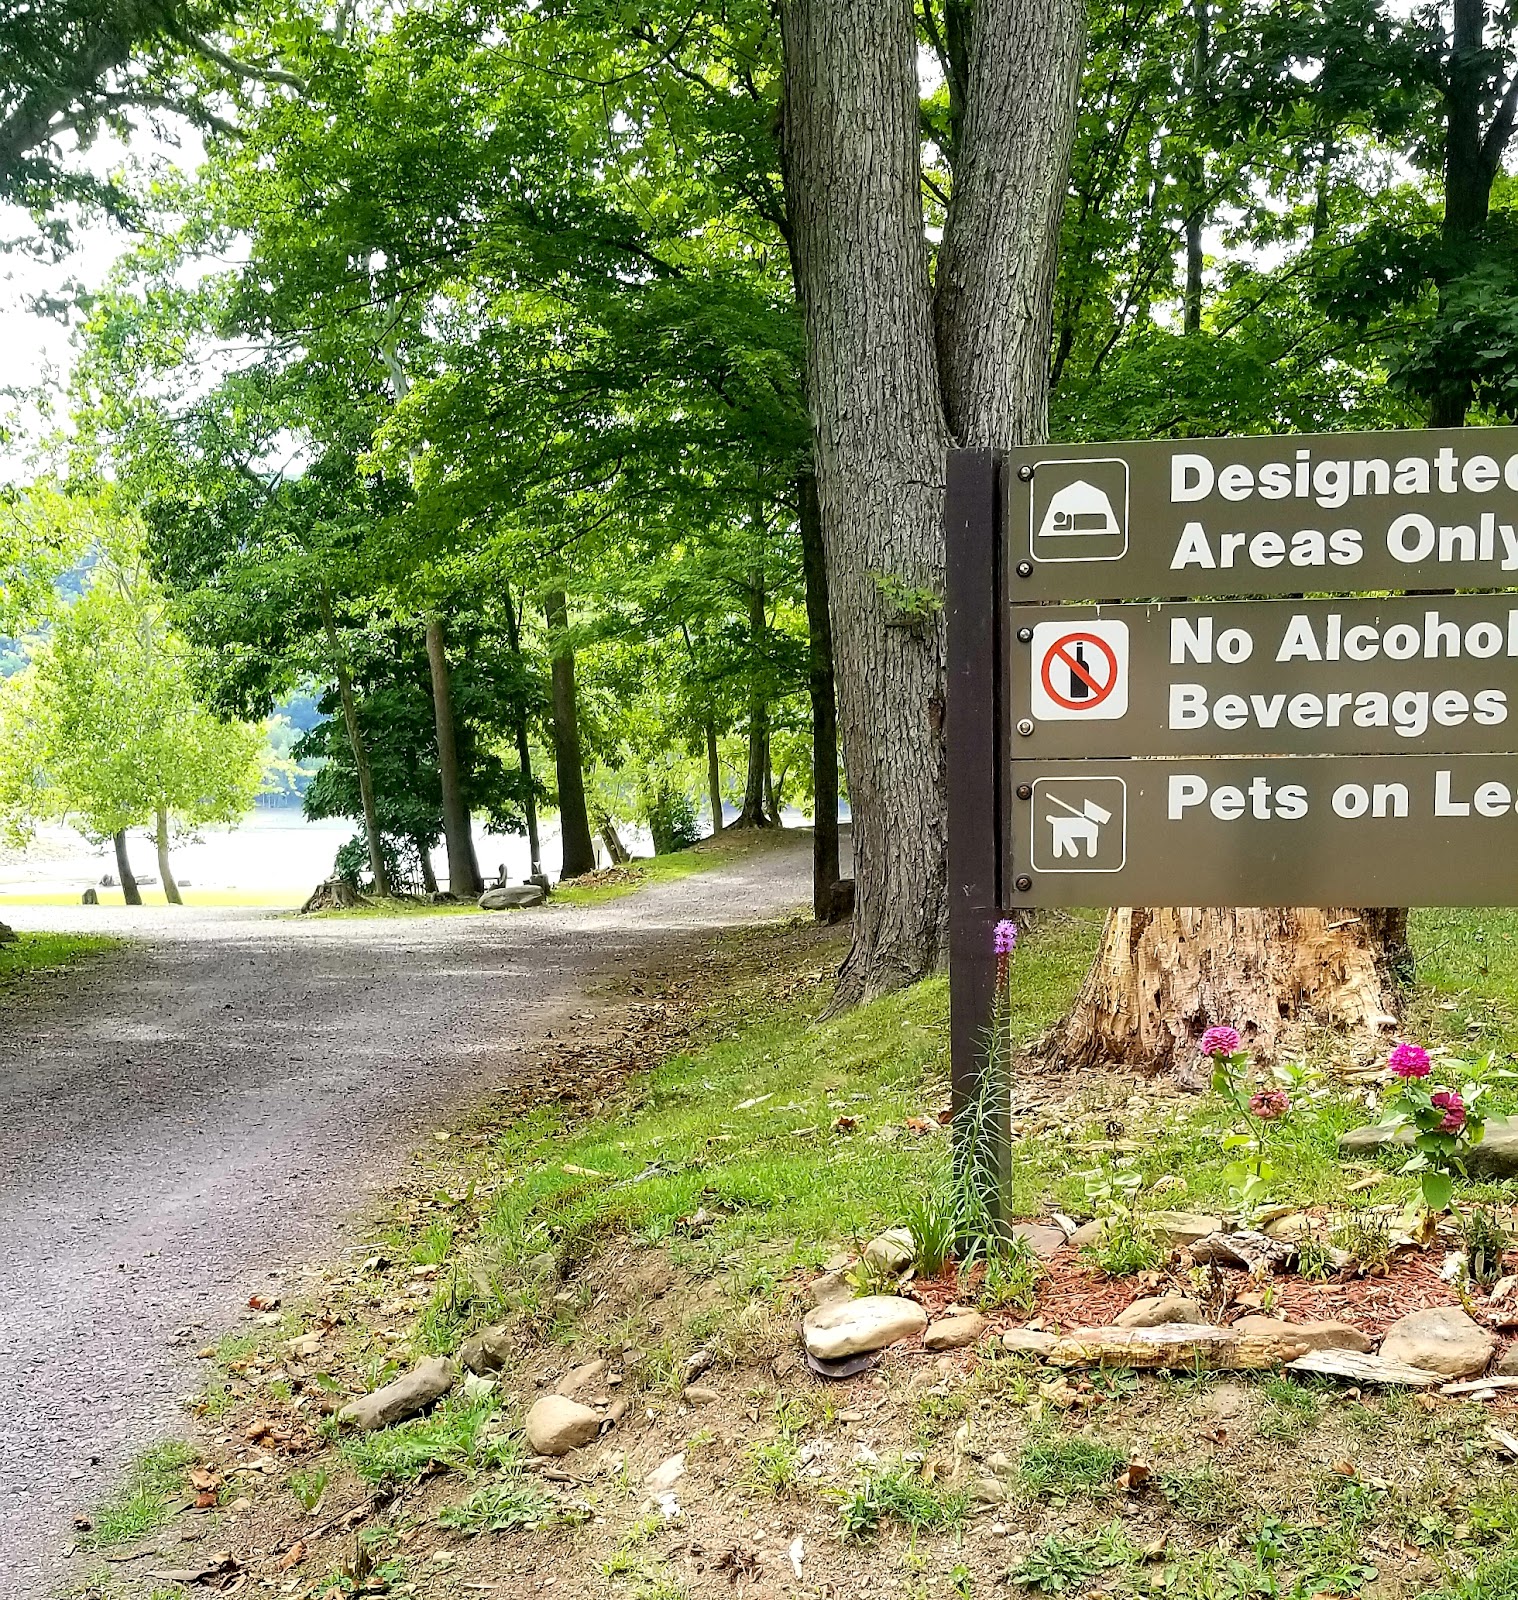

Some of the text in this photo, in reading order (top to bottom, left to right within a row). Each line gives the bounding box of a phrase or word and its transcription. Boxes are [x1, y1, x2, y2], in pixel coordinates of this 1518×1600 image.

[1170, 522, 1365, 570] Areas
[1170, 609, 1518, 664] No Alcohol
[1168, 684, 1508, 738] Beverages
[1168, 770, 1518, 820] Pets on Le
